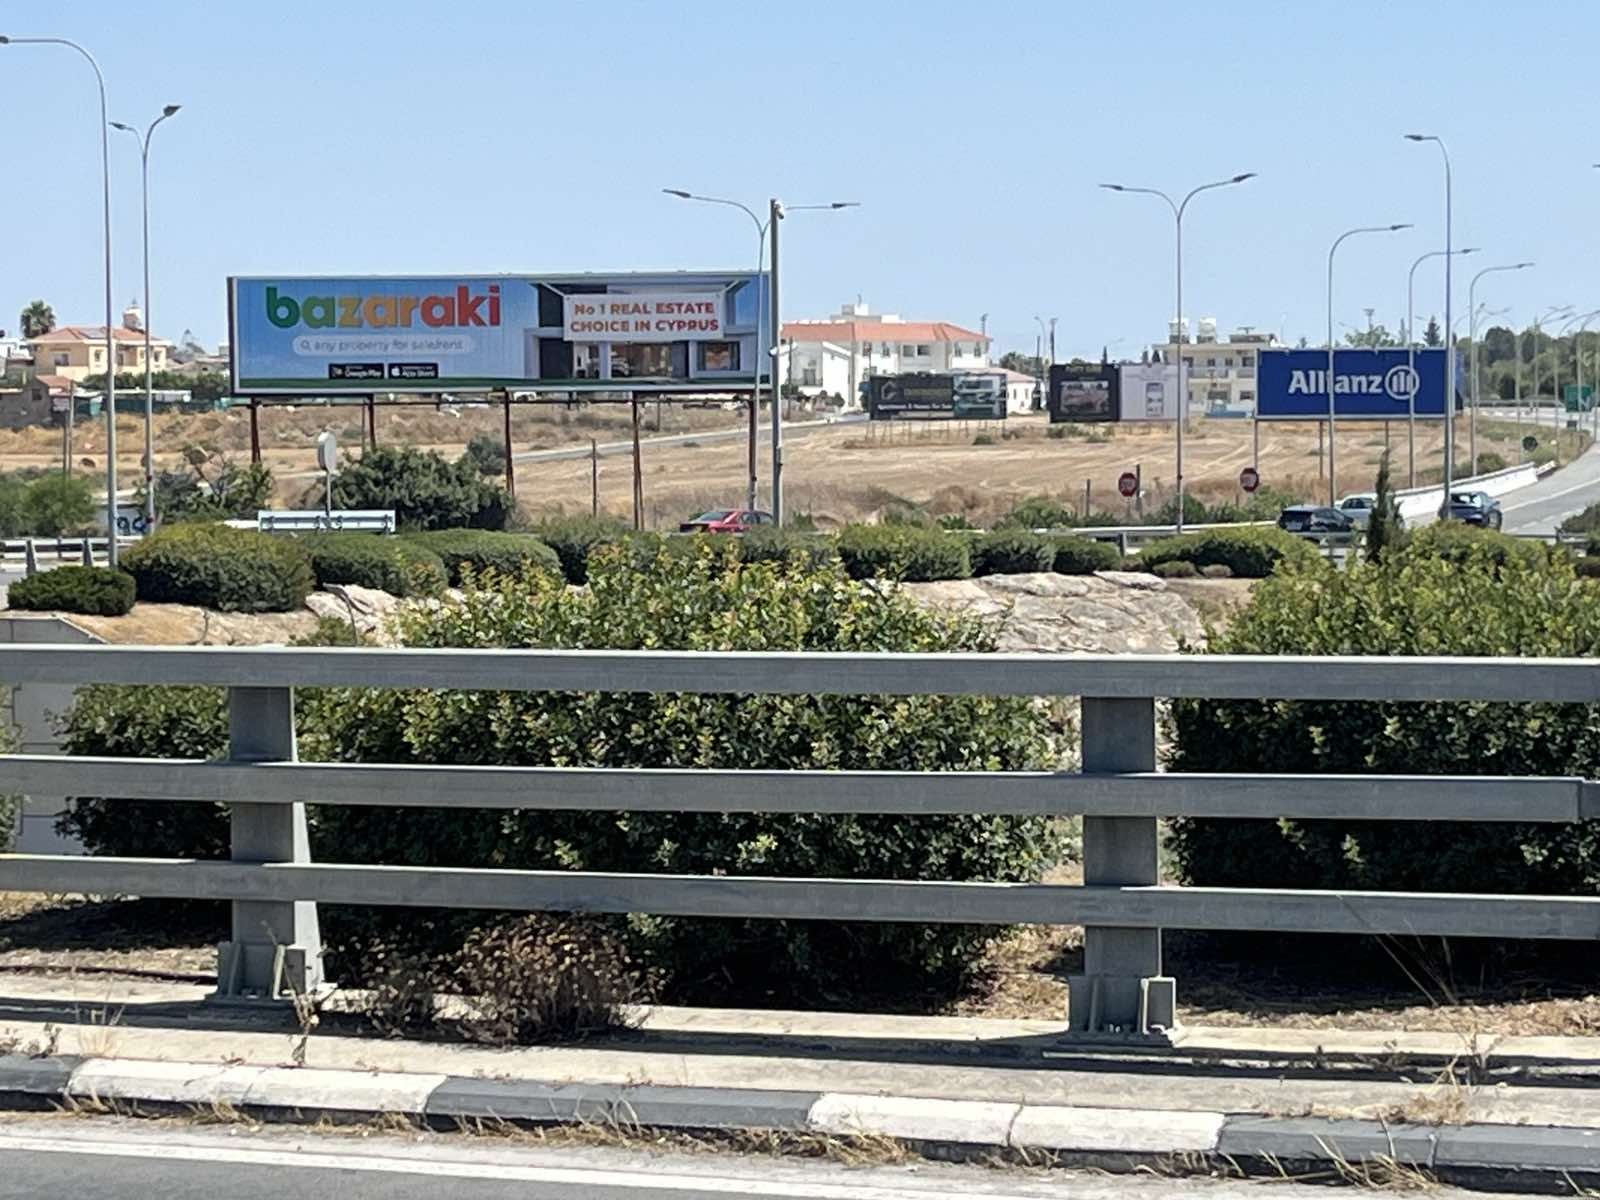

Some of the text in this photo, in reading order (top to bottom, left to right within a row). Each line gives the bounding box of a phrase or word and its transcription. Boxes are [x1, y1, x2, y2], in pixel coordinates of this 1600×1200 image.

[266, 285, 500, 328] bazaraki
[574, 302, 714, 315] No 1 REAL ESTATE
[570, 319, 719, 333] CHOICE IN CYPRUS
[314, 341, 334, 352] any
[1288, 370, 1383, 394] Allianz
